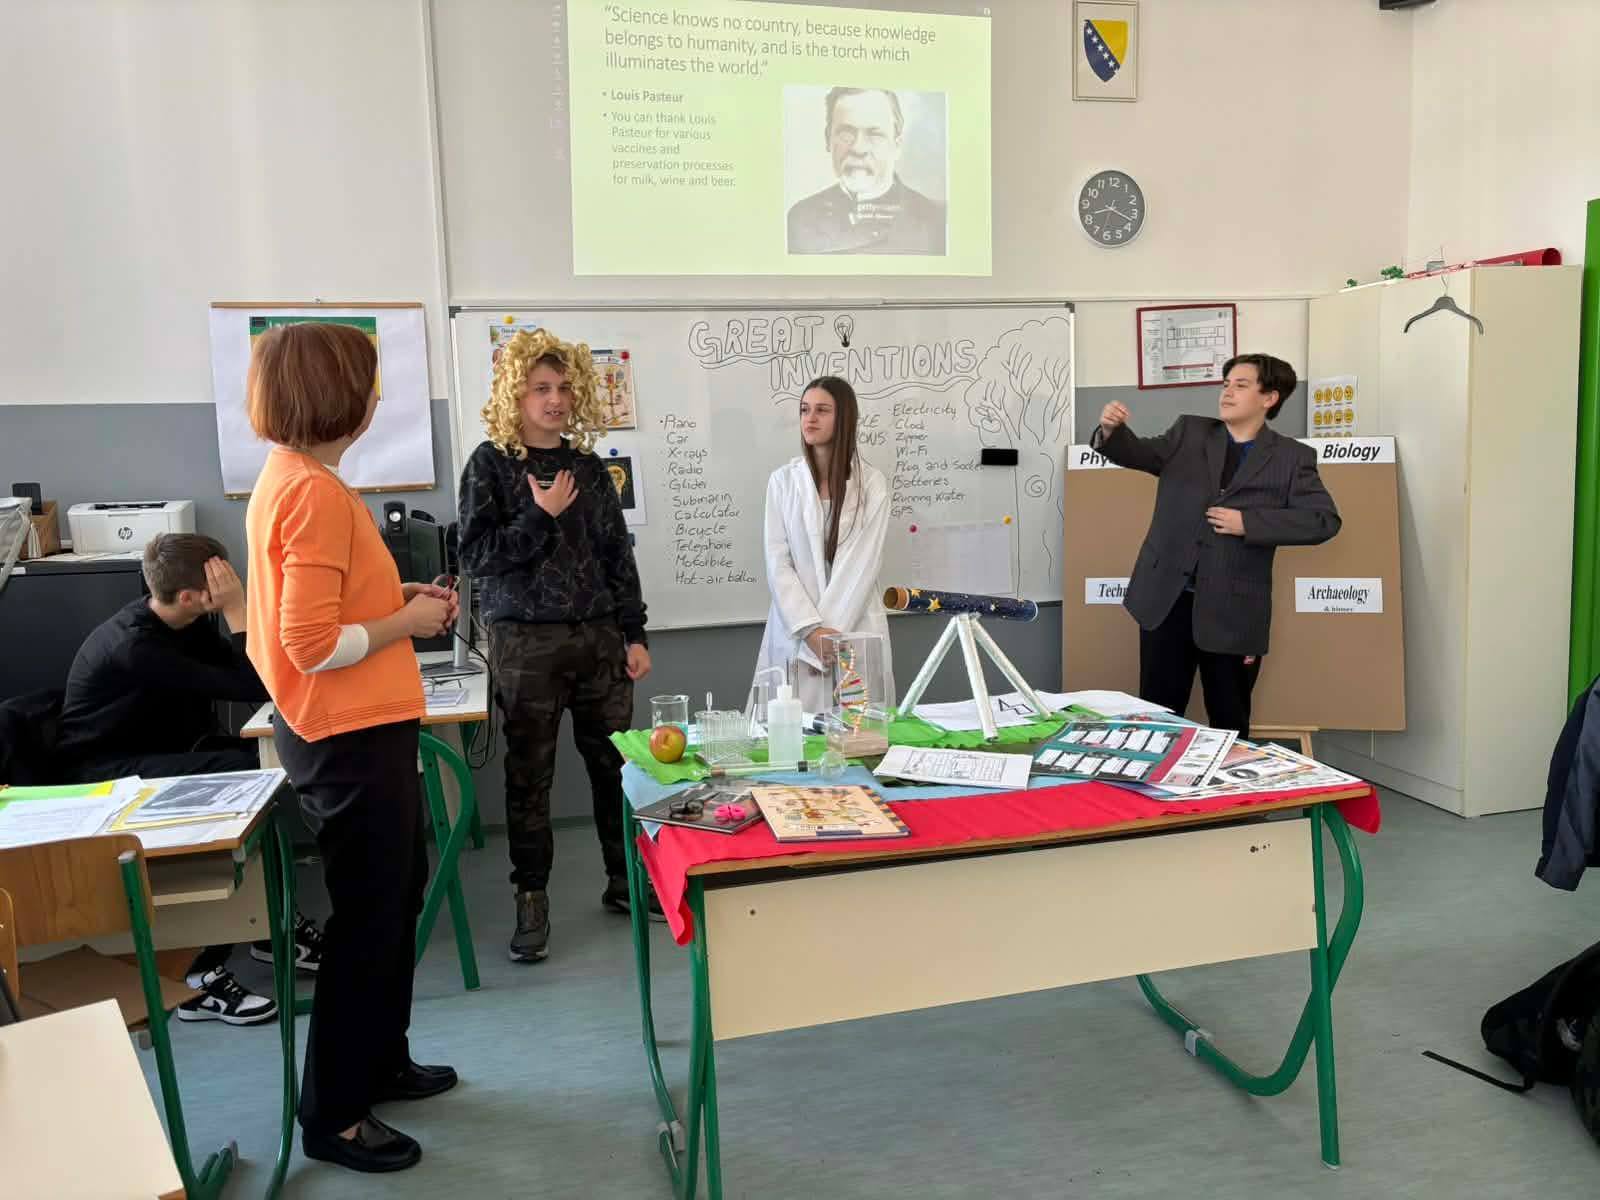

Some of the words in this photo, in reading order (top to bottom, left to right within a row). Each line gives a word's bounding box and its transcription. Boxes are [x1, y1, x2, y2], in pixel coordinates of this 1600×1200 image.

[604, 5, 669, 25] “Science
[673, 10, 719, 28] knows
[723, 16, 742, 30] no
[745, 17, 801, 37] country,
[806, 19, 862, 37] because
[865, 24, 936, 45] knowledge
[605, 27, 663, 50] belongs
[667, 35, 682, 48] to
[687, 33, 757, 56] humanity,
[761, 40, 787, 54] and
[792, 41, 802, 56] is
[806, 42, 829, 57] the
[833, 44, 867, 60] torch
[871, 47, 910, 61] which
[605, 52, 687, 71] illuminates
[690, 57, 714, 73] the
[718, 59, 768, 76] world.”
[611, 88, 640, 101] Louis
[643, 90, 684, 103] Pasteur
[611, 112, 631, 122] You
[633, 113, 653, 123] can
[655, 112, 686, 124] thank
[689, 113, 716, 125] Louis
[612, 126, 653, 138] Pasteur
[655, 127, 671, 138] for
[672, 128, 712, 140] various
[611, 143, 658, 154] vaccines
[660, 143, 681, 154] and
[612, 159, 680, 170] preservation
[683, 160, 734, 171] processes
[612, 174, 627, 185] for
[631, 174, 657, 187] milk,
[660, 175, 684, 185] wine
[688, 175, 708, 186] and
[711, 175, 736, 187] beer.
[1097, 179, 1105, 189] 11
[1109, 177, 1120, 188] 12
[1087, 187, 1099, 199] 10
[1081, 199, 1090, 209] 9
[1129, 195, 1137, 206] 2
[1084, 214, 1093, 225] 8
[1130, 208, 1138, 219] 3
[1093, 225, 1100, 235] 7
[1124, 222, 1131, 232] 4
[1103, 230, 1111, 240] 6
[1115, 229, 1122, 239] 5
[688, 315, 824, 361] GREAT
[770, 339, 978, 391] INVENTIONS
[893, 402, 957, 421] Electricity
[666, 431, 689, 444] Car
[667, 447, 708, 464] X-rays
[896, 445, 928, 459] Wi-Fi
[1322, 442, 1381, 461] Biology
[926, 460, 948, 471] and
[1080, 451, 1109, 467] Phy
[668, 462, 704, 476] Radio
[674, 504, 740, 520] Calculator
[890, 505, 913, 517] GPS
[675, 522, 728, 537] Bicycle
[672, 538, 733, 553] Telephone
[1307, 584, 1369, 605] Archaeology
